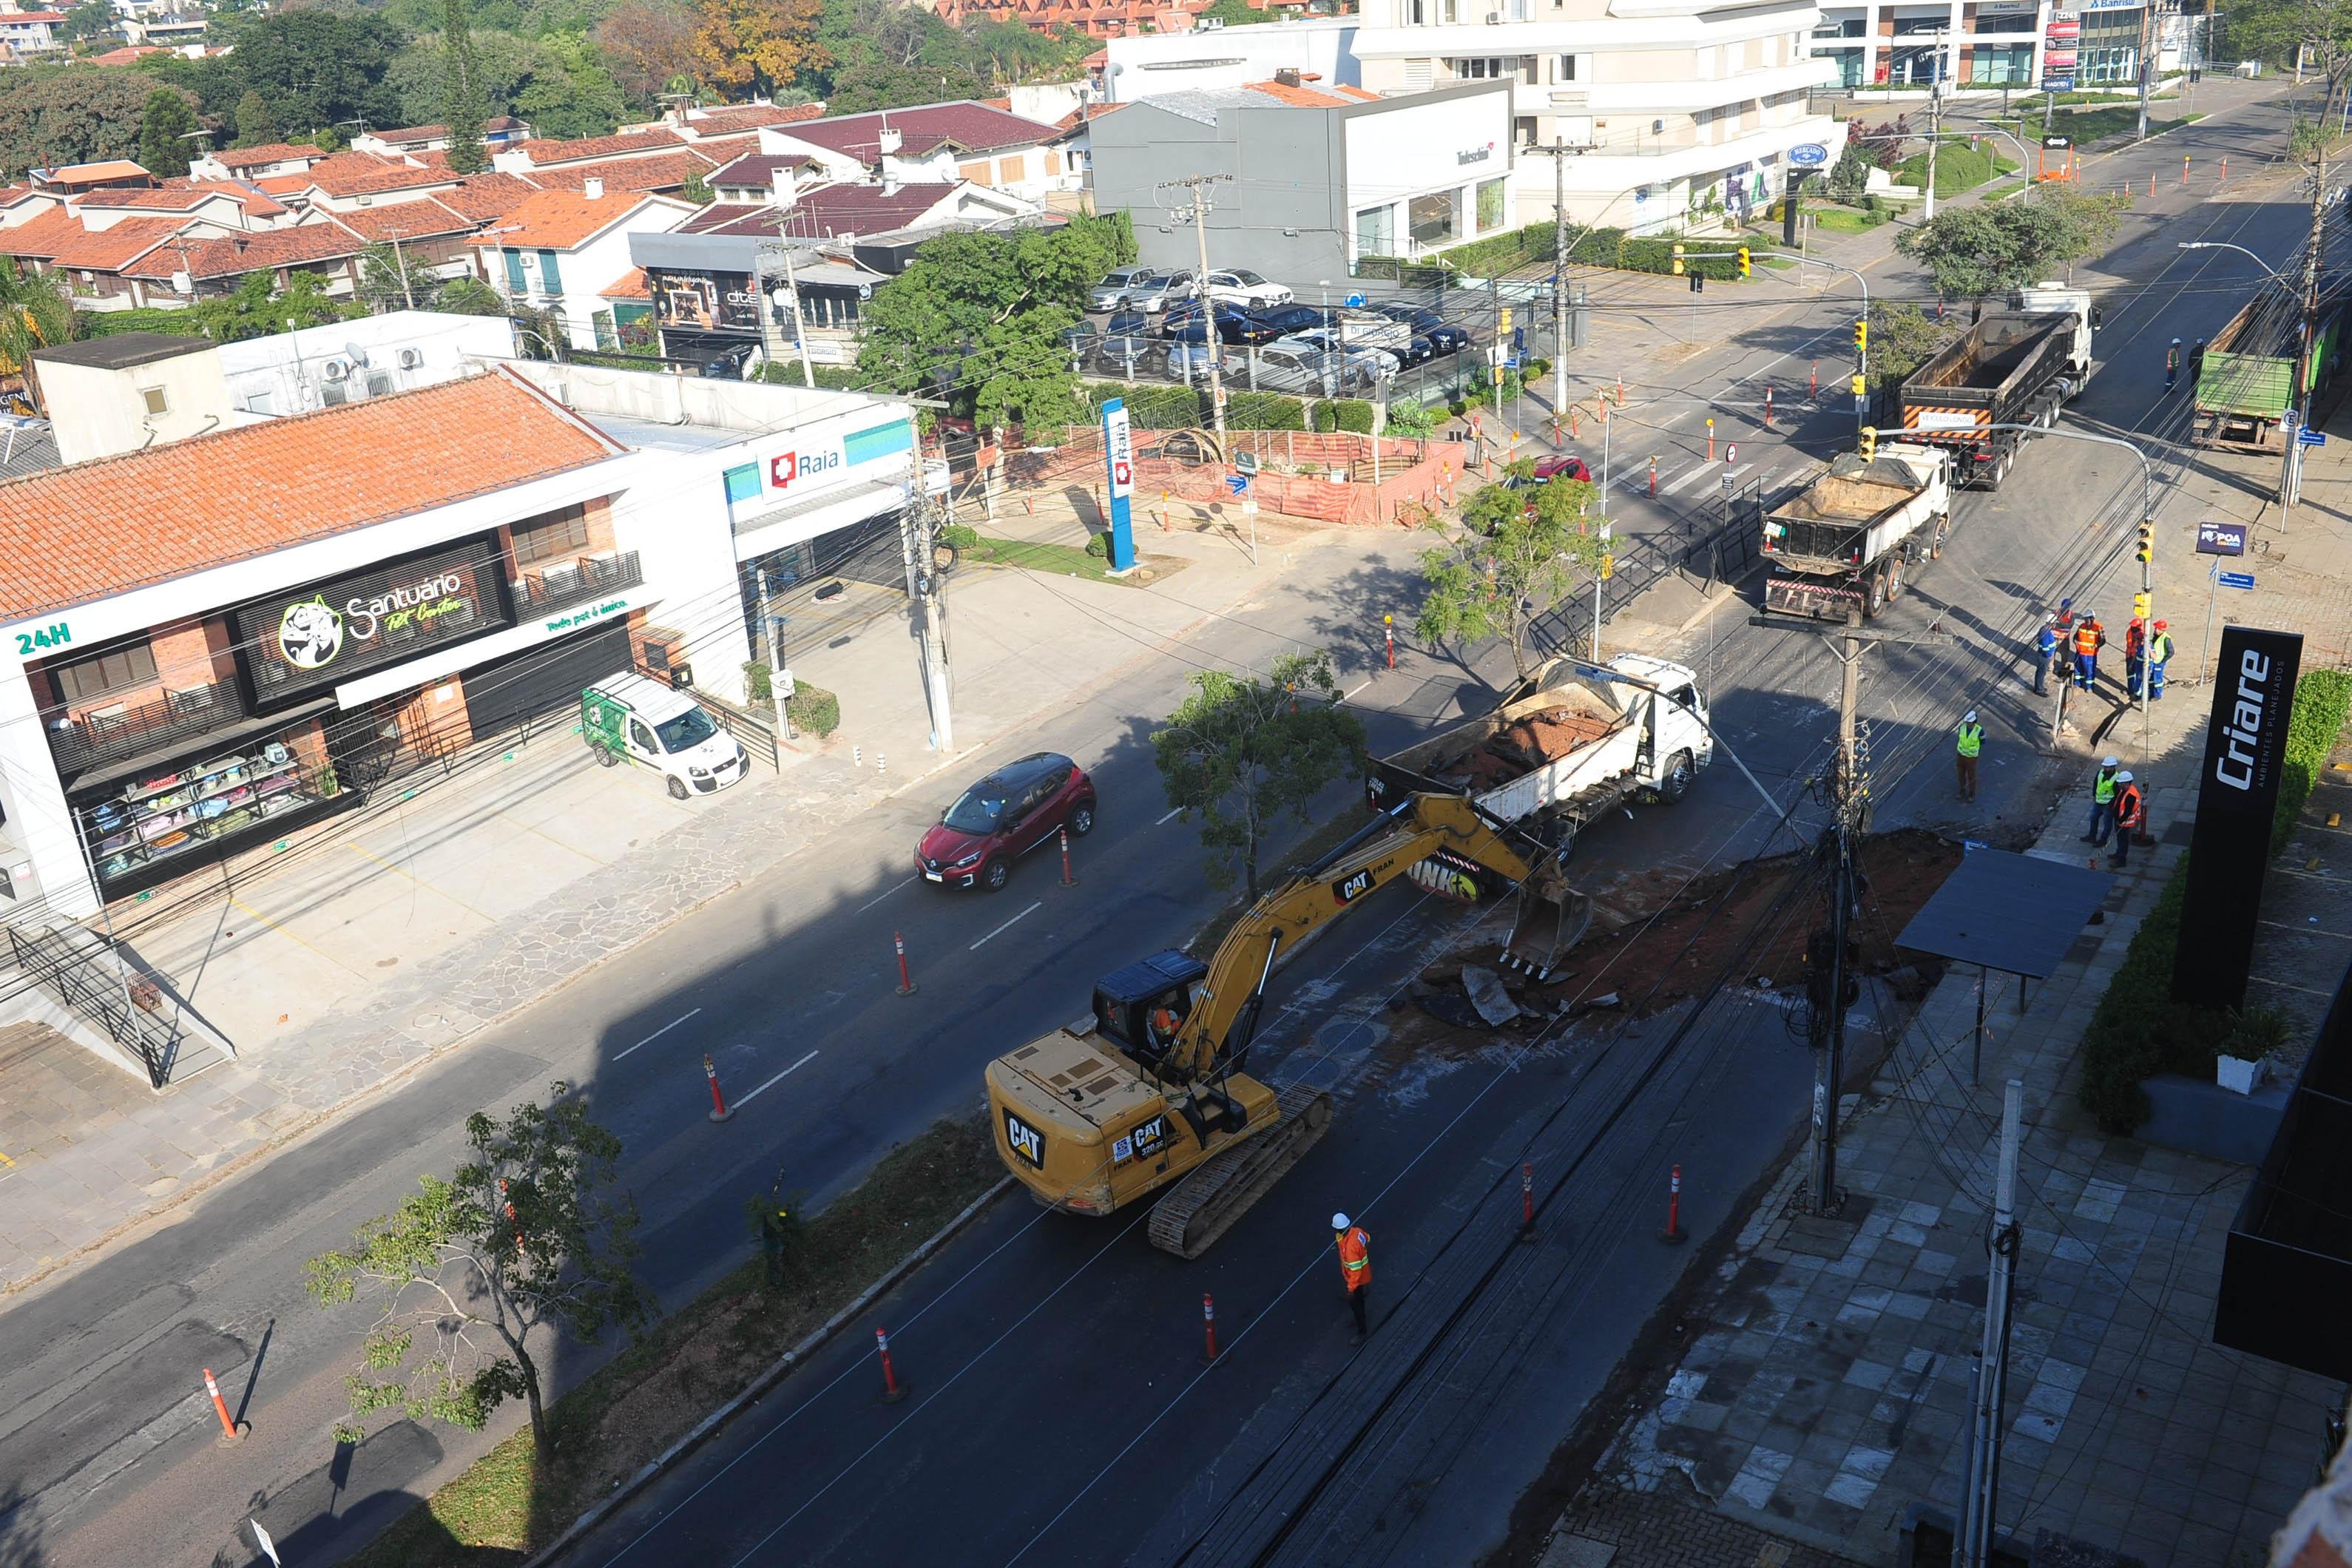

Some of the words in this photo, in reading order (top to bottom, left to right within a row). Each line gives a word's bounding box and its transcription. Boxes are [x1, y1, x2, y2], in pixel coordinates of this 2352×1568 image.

[1351, 326, 1359, 334] DI
[1362, 328, 1400, 338] GIORGIO
[1116, 422, 1129, 459] Raia
[800, 450, 839, 477] Raia
[346, 574, 462, 640] Santuário
[416, 597, 462, 621] Center
[15, 622, 72, 655] 24H
[2216, 649, 2271, 791] Criare
[2257, 731, 2274, 788] AMBIENTES
[2267, 660, 2285, 727] PLANEJADOS
[1343, 871, 1367, 899] CAT
[1373, 857, 1395, 876] FRAN
[1009, 1117, 1040, 1163] CAT
[1135, 1118, 1161, 1148] CAT
[1114, 1157, 1132, 1172] FRAN
